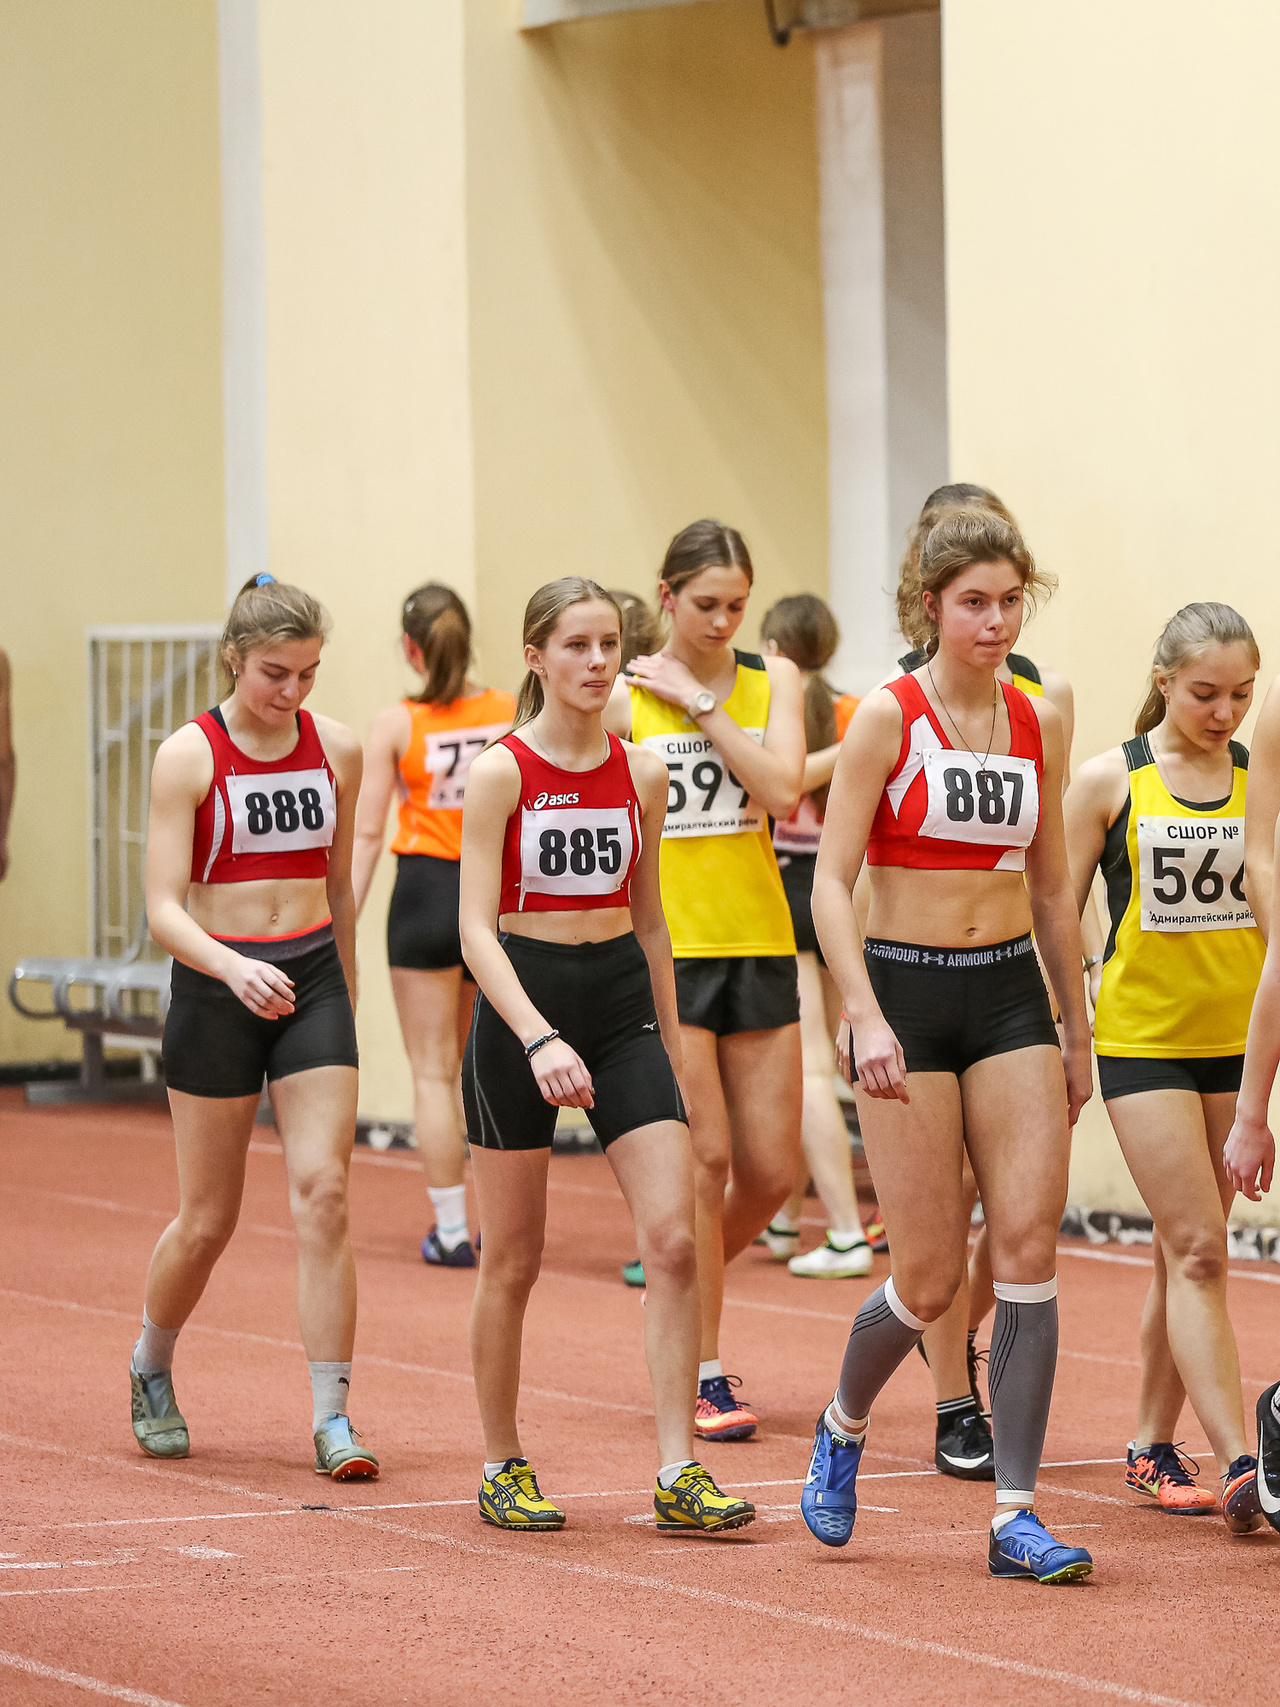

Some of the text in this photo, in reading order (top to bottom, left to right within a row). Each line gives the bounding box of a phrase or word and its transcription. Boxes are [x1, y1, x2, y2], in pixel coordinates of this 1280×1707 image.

[245, 788, 324, 835] 888
[943, 767, 1024, 827] 887
[1166, 825, 1240, 840] СШОР №
[538, 827, 622, 877] 885
[1150, 912, 1234, 926] Адмиралтейский
[947, 950, 994, 967] ARMOUR
